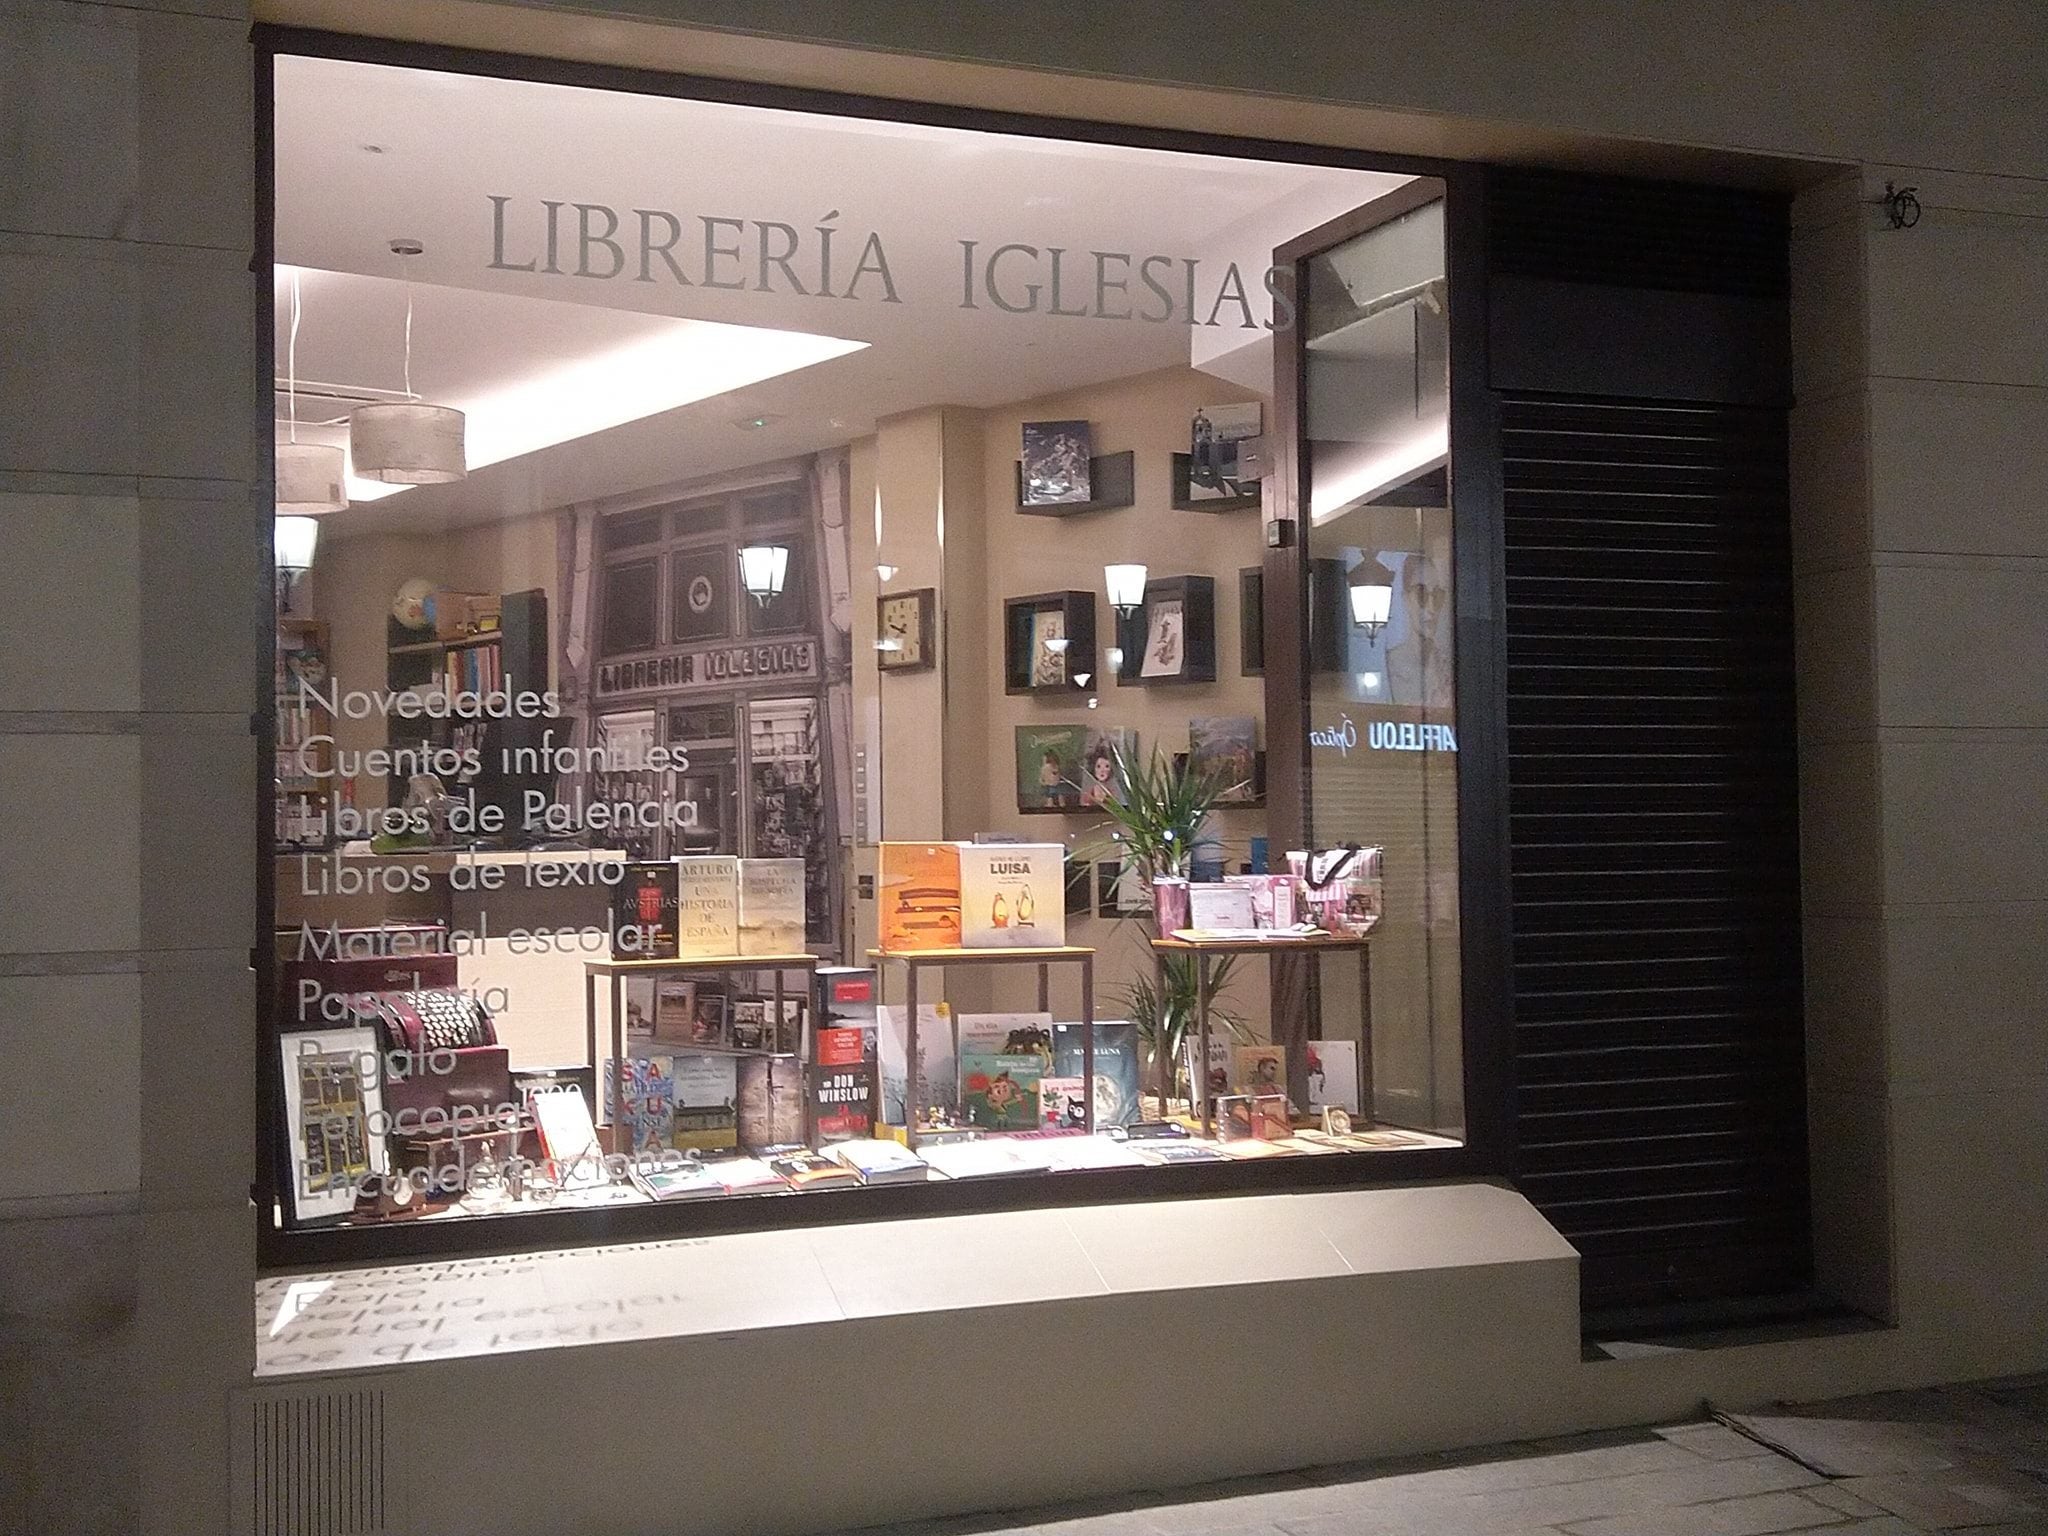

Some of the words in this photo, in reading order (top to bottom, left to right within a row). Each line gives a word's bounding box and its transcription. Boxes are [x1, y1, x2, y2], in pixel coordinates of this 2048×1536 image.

[486, 194, 903, 304] LIBRERÍA
[958, 238, 1299, 334] IGLESIAS
[298, 672, 561, 720] Novedades
[297, 734, 482, 778] Cuentos
[501, 729, 691, 776] infantiles
[299, 790, 430, 837] Libros
[448, 786, 505, 834] de
[523, 786, 699, 832] Palencia
[299, 851, 431, 897] Libros
[448, 845, 506, 891] de
[524, 852, 626, 889] texto
[681, 864, 733, 877] ARTURO
[990, 863, 1031, 874] LUISA
[297, 910, 487, 963] Material
[507, 907, 664, 956] escolar
[818, 1086, 869, 1104] WINSLOW
[833, 1074, 854, 1089] DON
